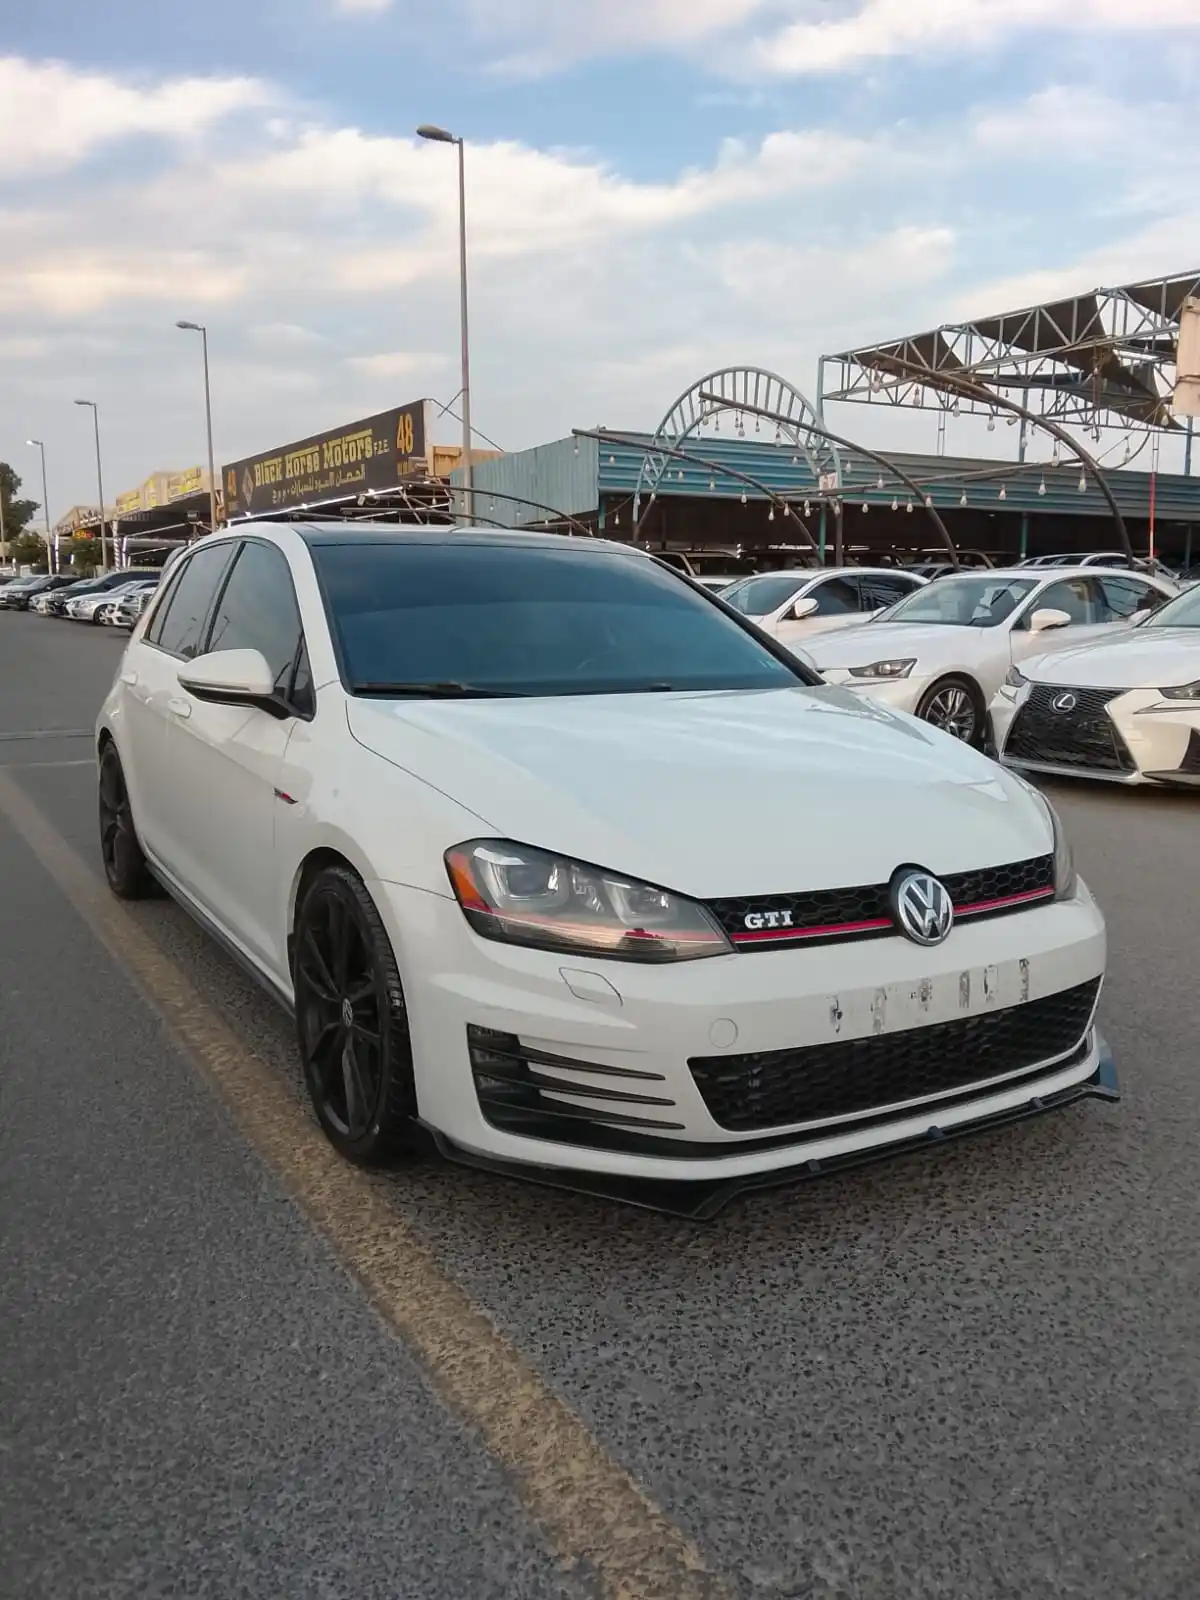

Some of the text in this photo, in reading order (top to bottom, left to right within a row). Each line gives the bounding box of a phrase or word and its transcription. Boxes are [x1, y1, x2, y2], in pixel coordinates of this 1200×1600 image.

[396, 412, 414, 455] 48
[254, 456, 283, 487] Black
[285, 444, 320, 479] Horse
[322, 428, 373, 469] Motors
[744, 910, 795, 930] GTI
